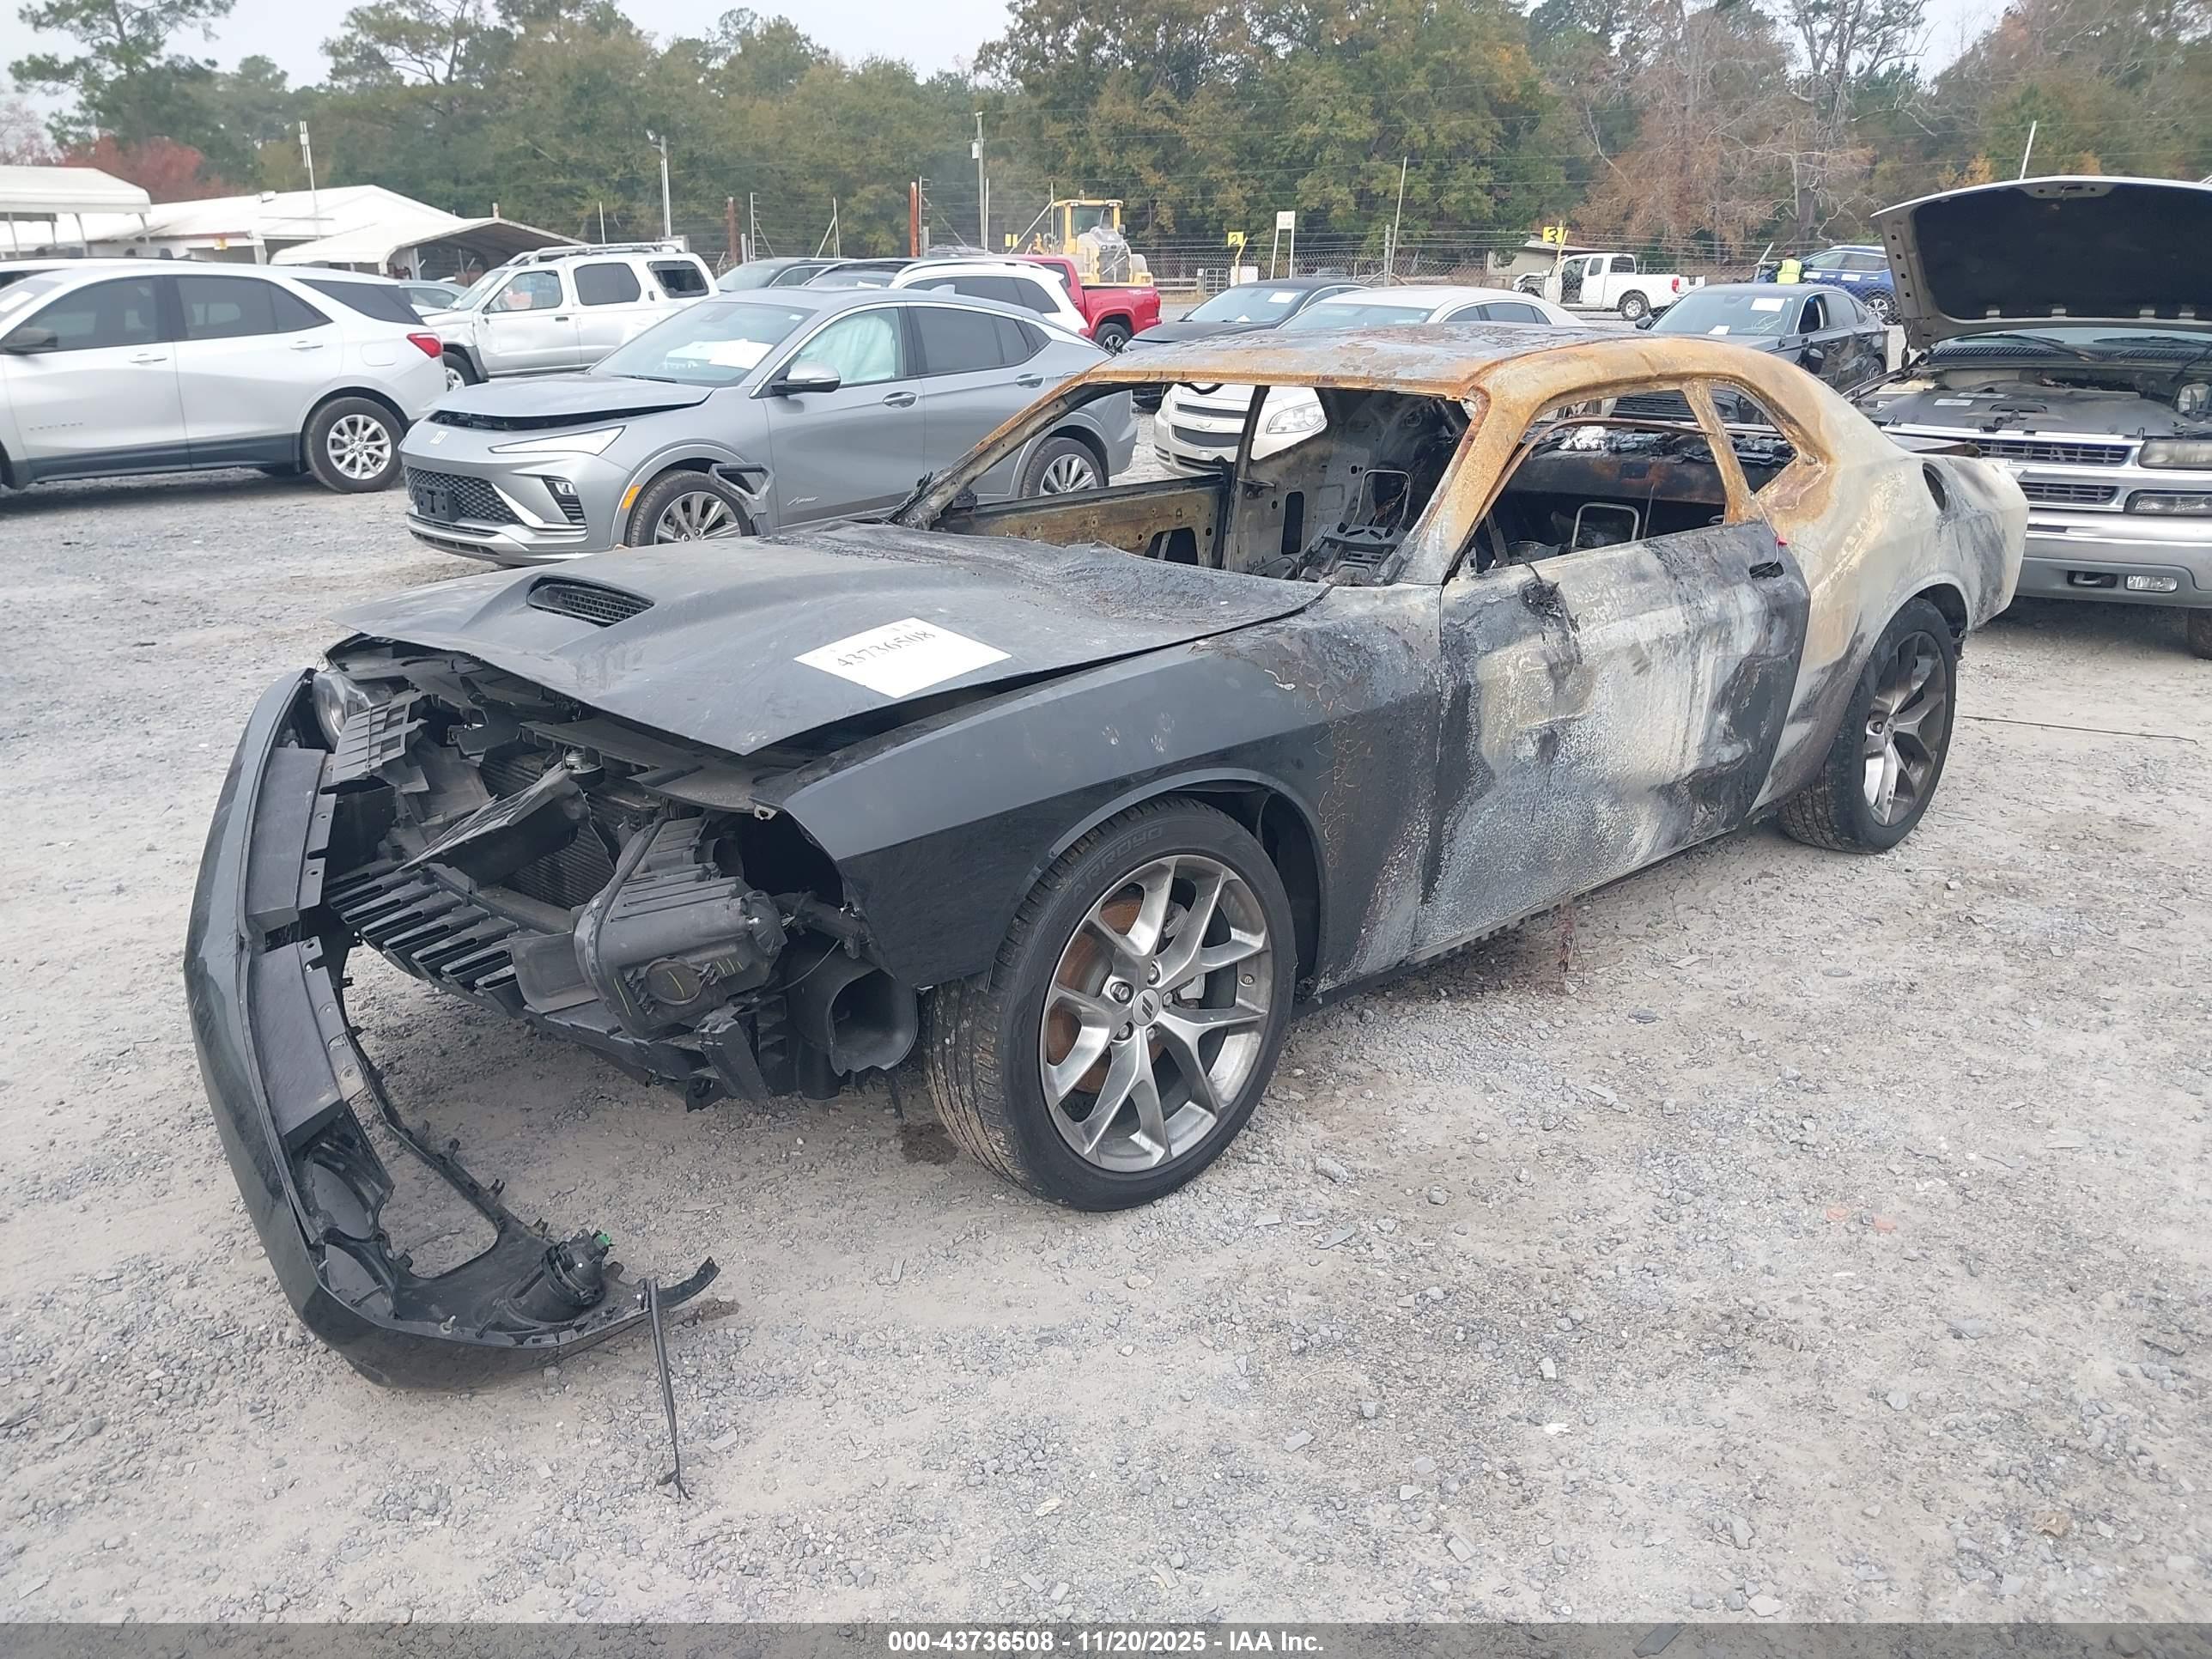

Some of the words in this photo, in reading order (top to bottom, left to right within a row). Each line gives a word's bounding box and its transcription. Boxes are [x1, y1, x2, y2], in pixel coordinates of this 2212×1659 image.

[1230, 234, 1241, 247] 2
[1547, 228, 1559, 243] 3
[837, 630, 936, 666] 43736508
[1073, 826, 1162, 898] ARROYO
